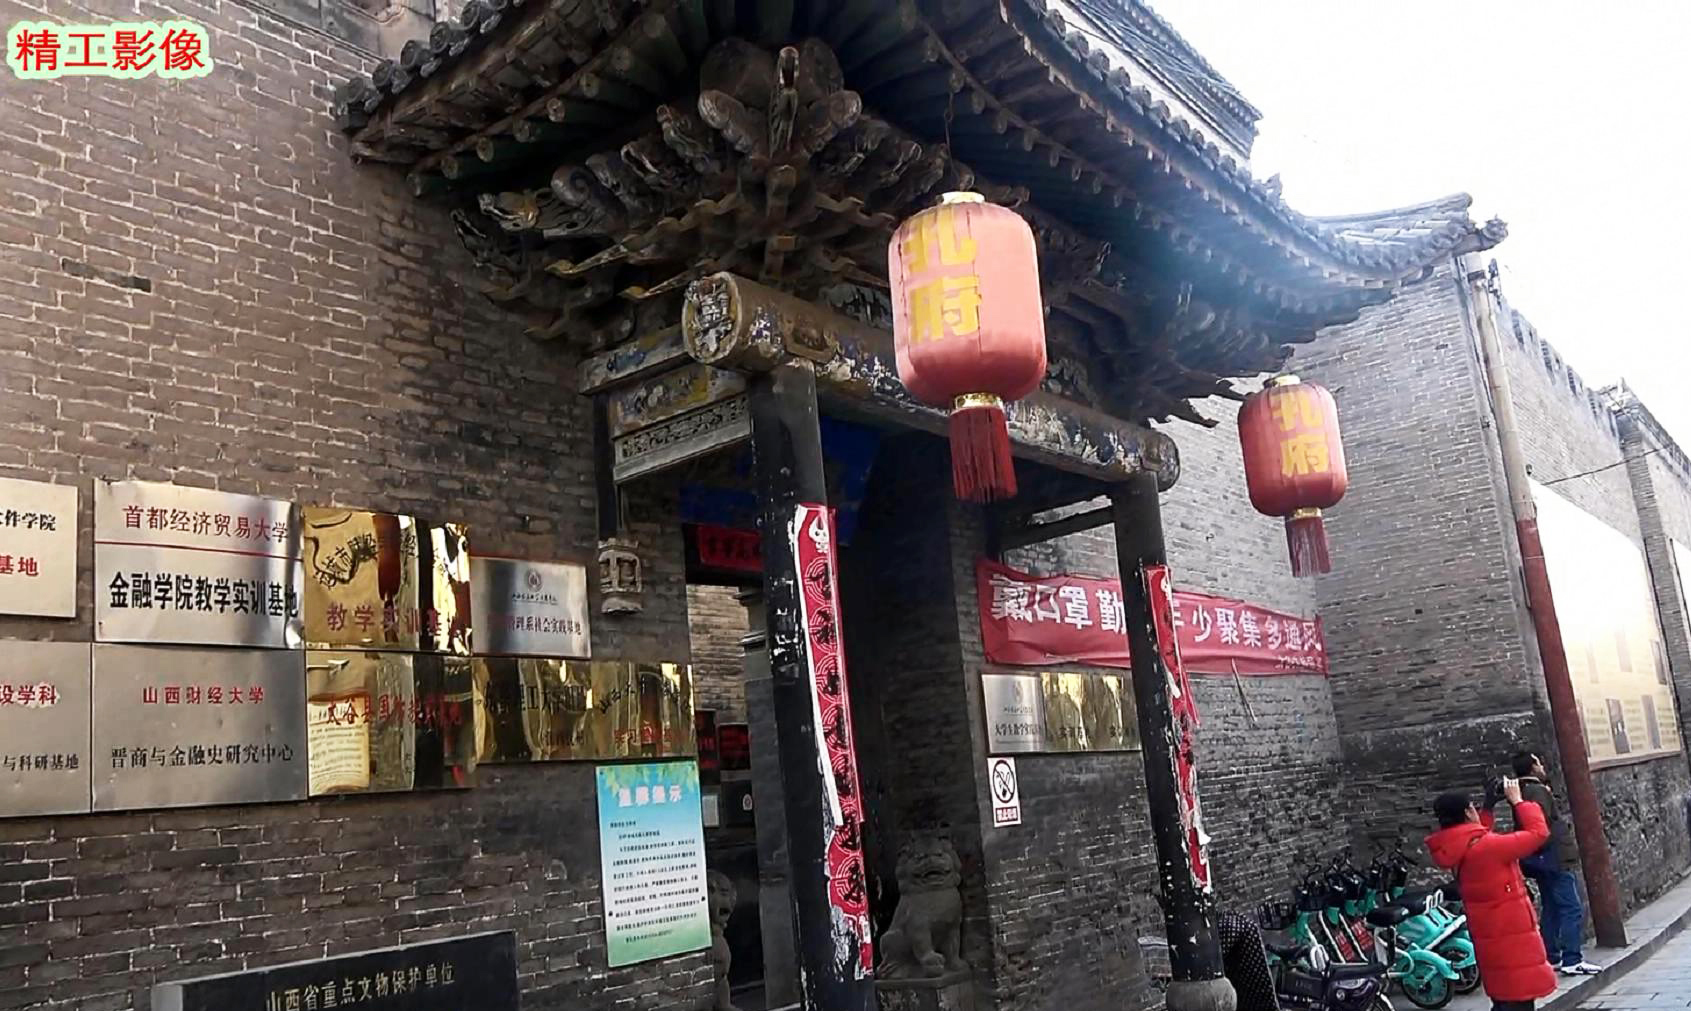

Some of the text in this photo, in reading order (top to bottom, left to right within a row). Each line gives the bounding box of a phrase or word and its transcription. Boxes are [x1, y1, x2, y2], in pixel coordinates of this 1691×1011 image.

[904, 206, 981, 343] 孔府
[1270, 391, 1329, 477] 孔府
[0, 508, 56, 531] 件学院
[122, 505, 289, 543] 首都经济贸易大学
[109, 571, 299, 618] 金融学院教学实训基地
[989, 574, 1323, 651] 戴口罩勤少聚集多通风
[142, 686, 265, 705] 山西财经大学
[3, 753, 80, 772] 与科研基地
[110, 743, 295, 769] 晋商与金融史研究中心
[266, 961, 455, 1011] 山西省重点文物保护单位
